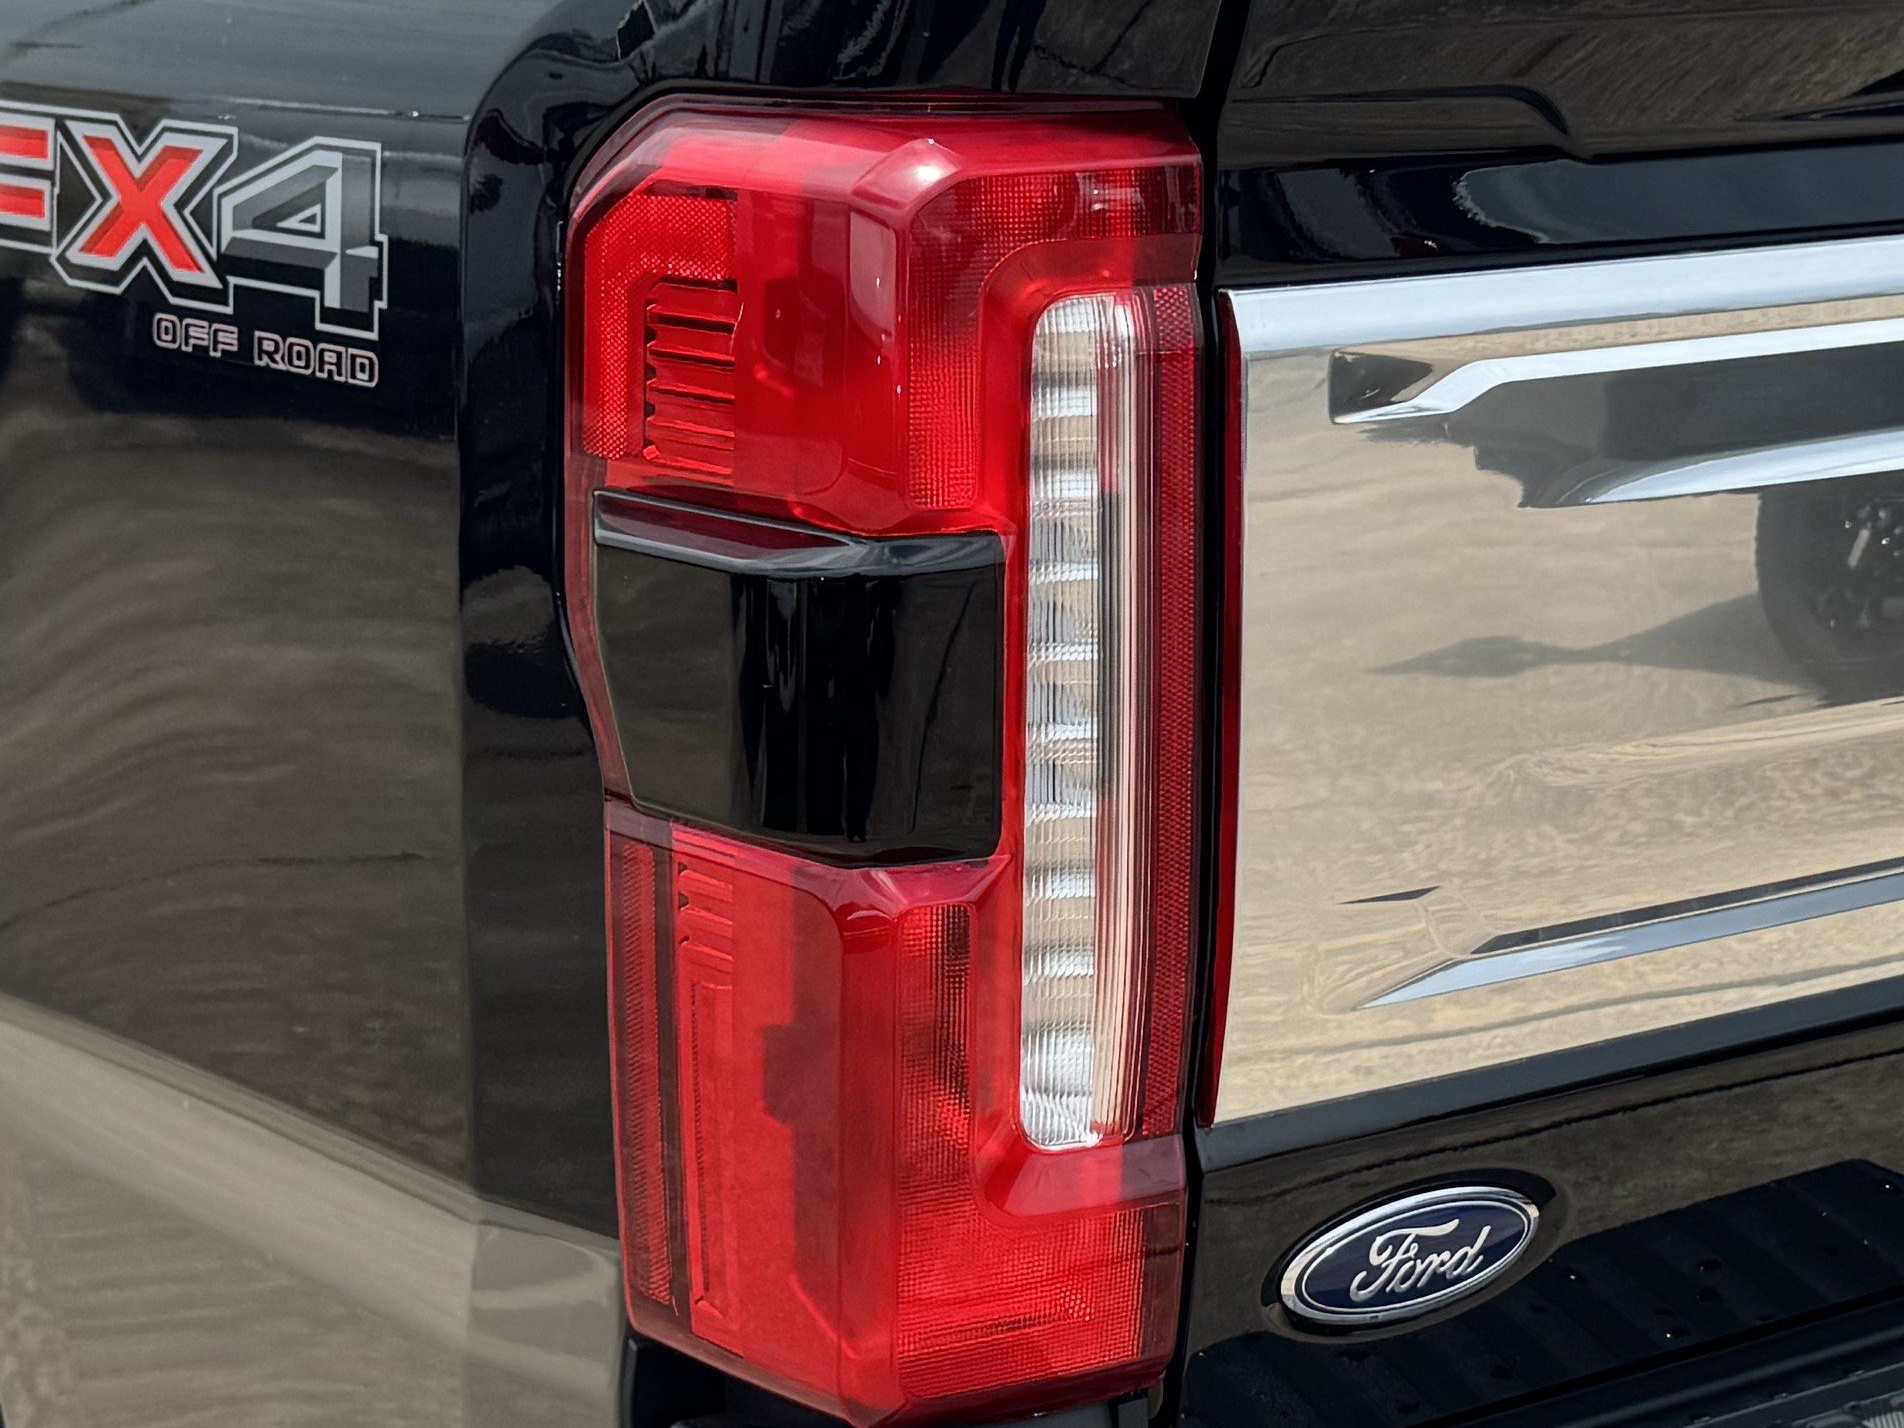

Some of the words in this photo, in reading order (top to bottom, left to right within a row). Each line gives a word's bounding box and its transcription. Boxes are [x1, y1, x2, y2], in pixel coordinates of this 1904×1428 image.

[152, 313, 238, 357] OFF
[253, 330, 379, 388] ROAD
[1349, 1218, 1492, 1303] Ford
